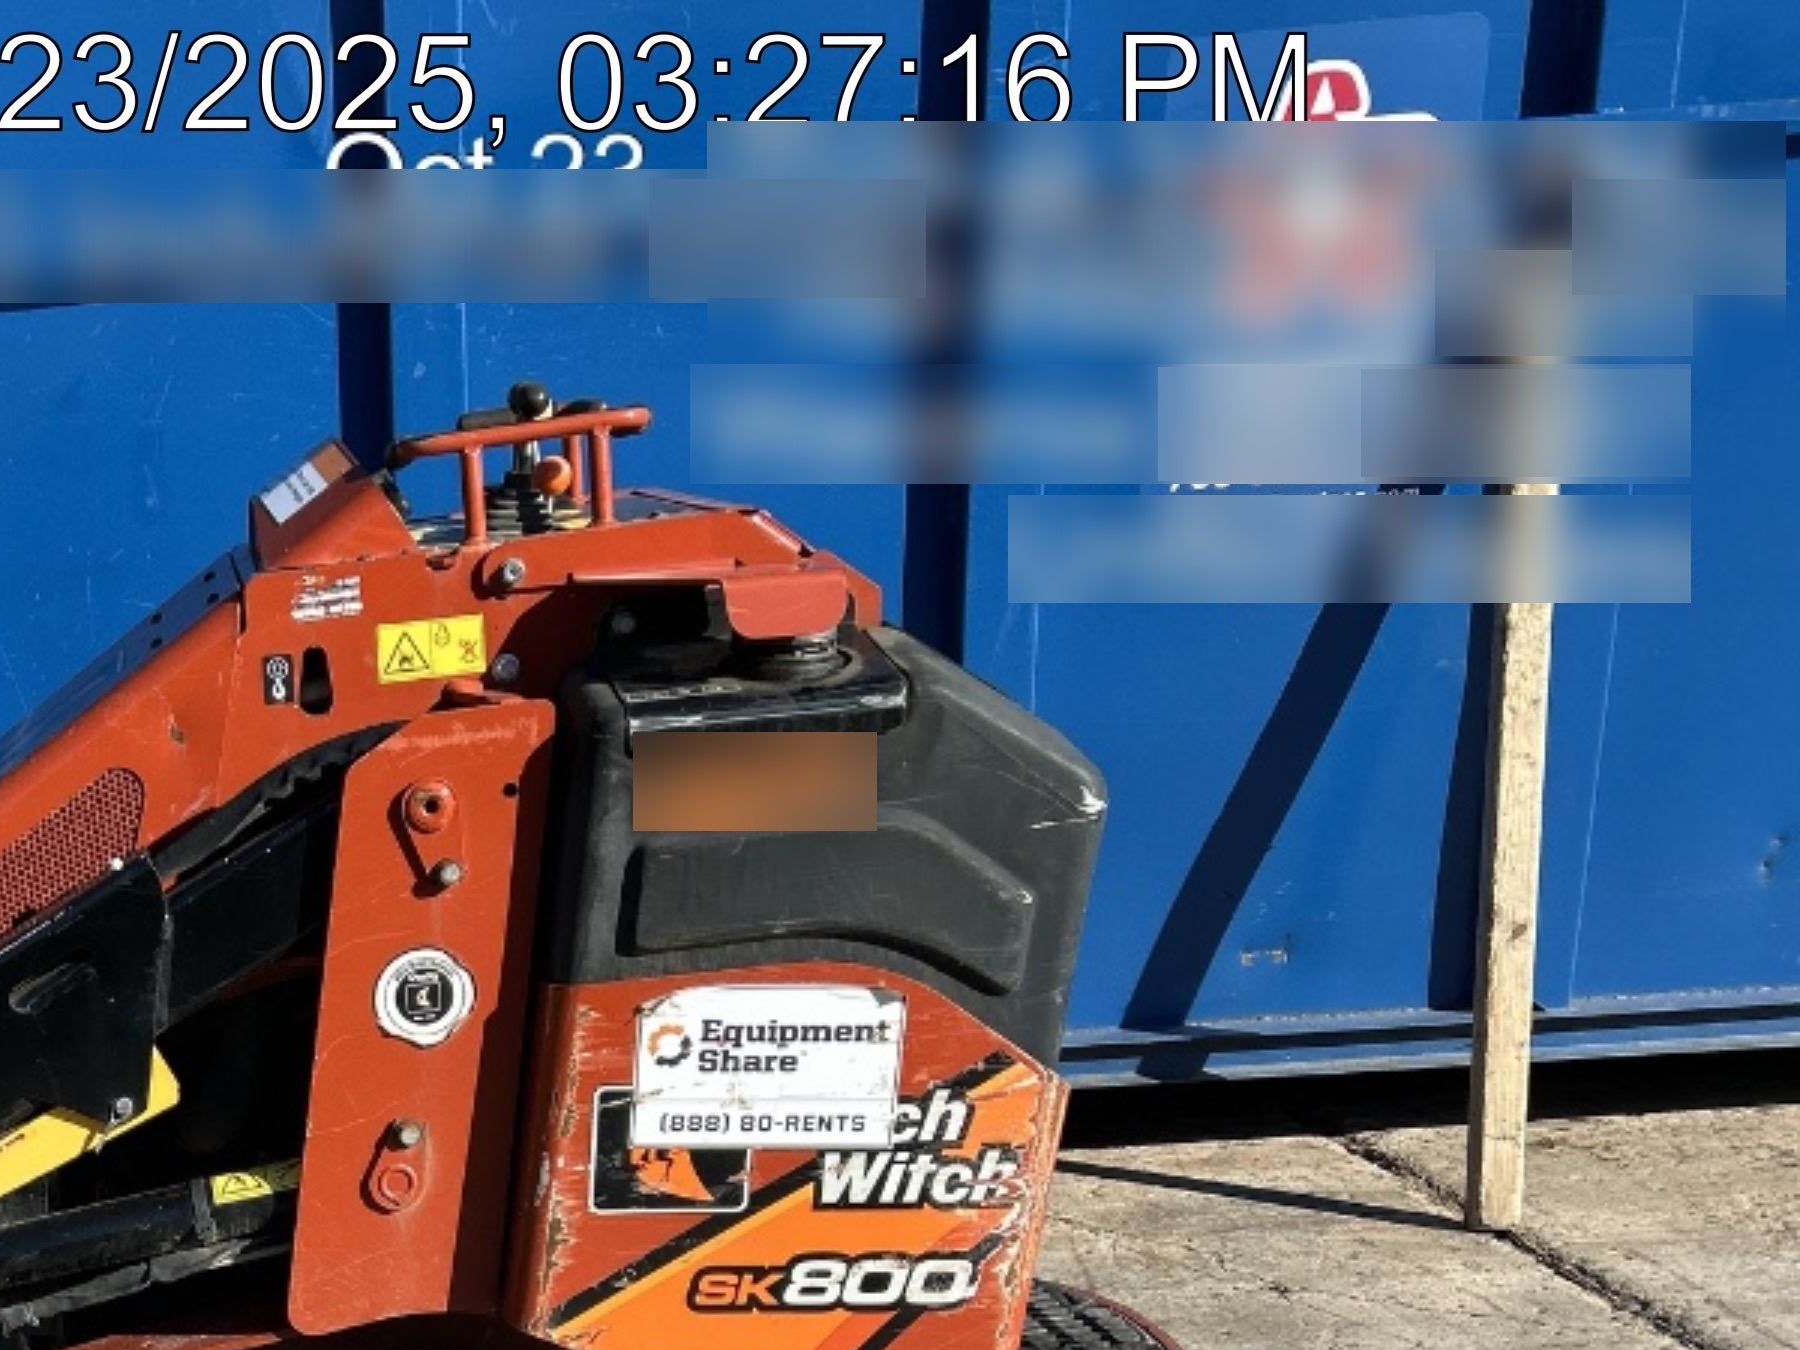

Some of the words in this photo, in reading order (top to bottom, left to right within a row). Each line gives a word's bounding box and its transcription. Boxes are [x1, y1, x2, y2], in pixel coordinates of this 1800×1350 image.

[700, 1018, 890, 1048] Equipment
[697, 1049, 798, 1073] Share
[659, 1112, 730, 1134] (888)
[739, 1114, 867, 1132] 80-RENTS
[819, 1149, 1022, 1205] Witch
[694, 1258, 980, 1307] SK800
